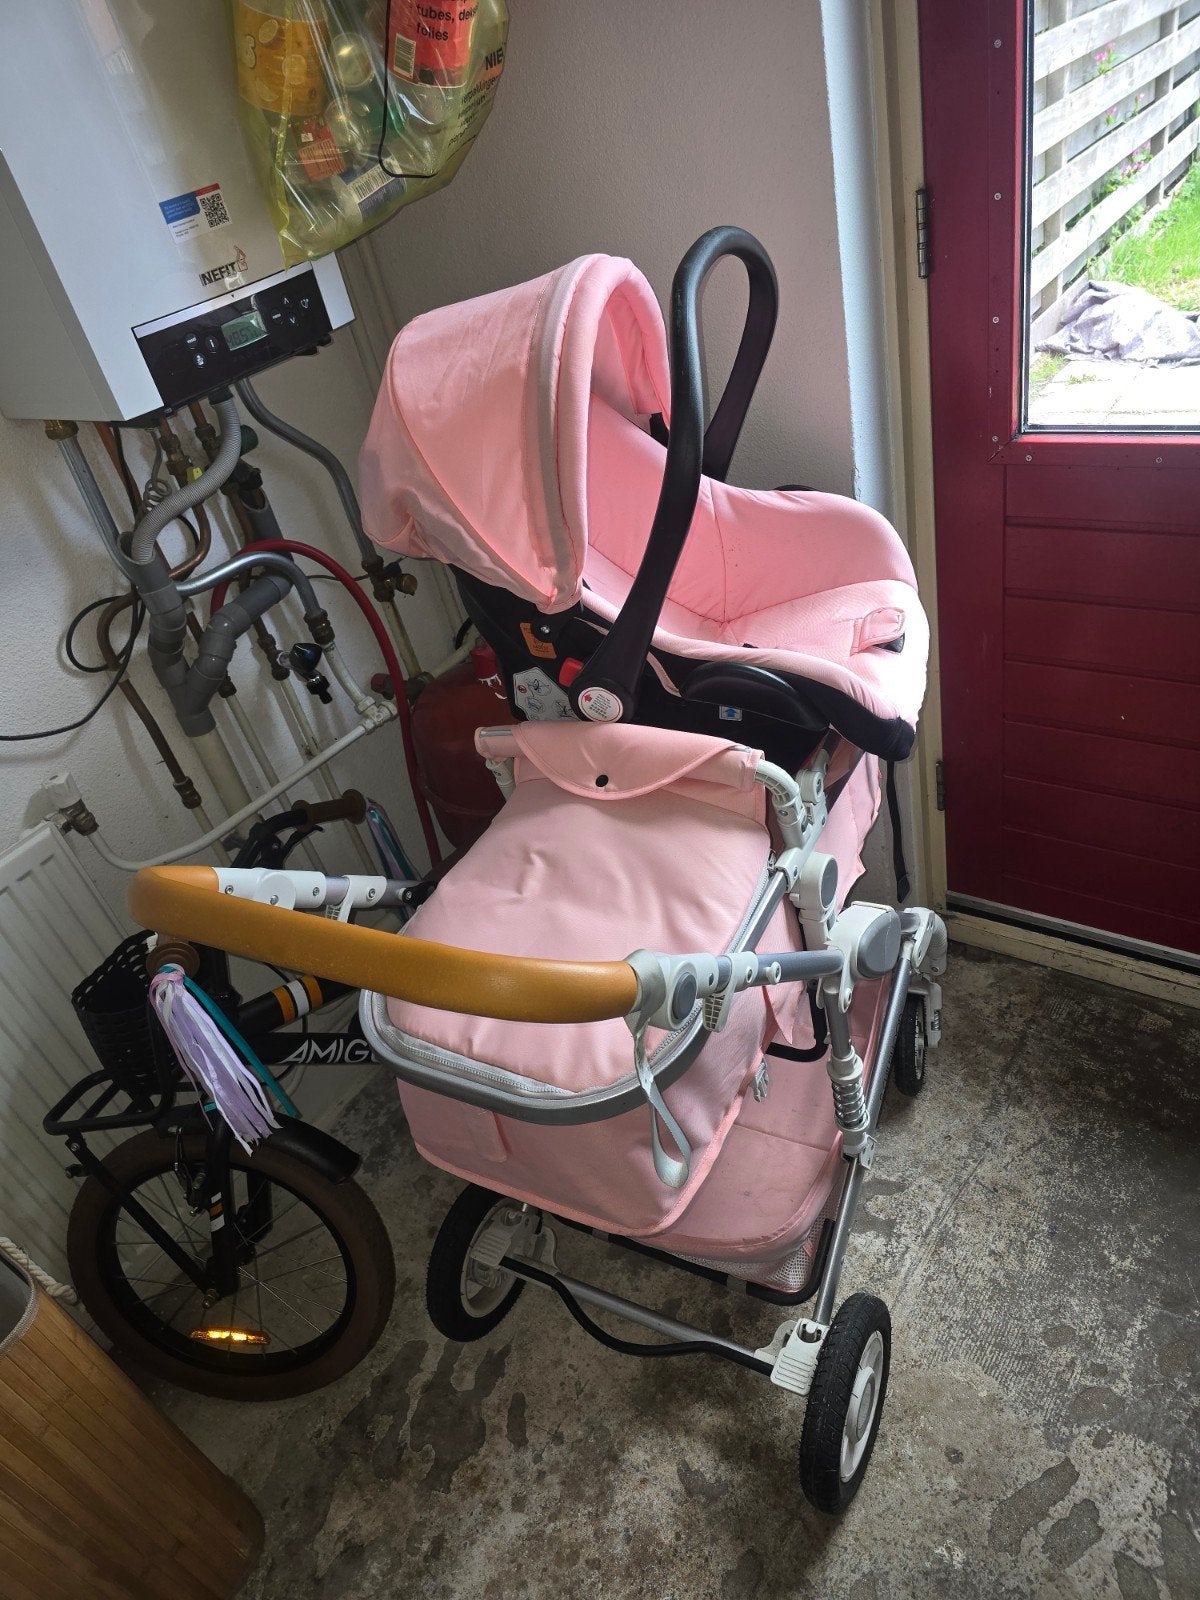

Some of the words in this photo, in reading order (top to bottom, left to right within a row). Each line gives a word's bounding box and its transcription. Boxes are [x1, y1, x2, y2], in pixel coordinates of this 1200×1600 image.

[416, 3, 455, 23] tubes,
[416, 21, 449, 41] folies
[201, 261, 237, 286] NEFIT
[276, 1038, 381, 1064] AMIG
